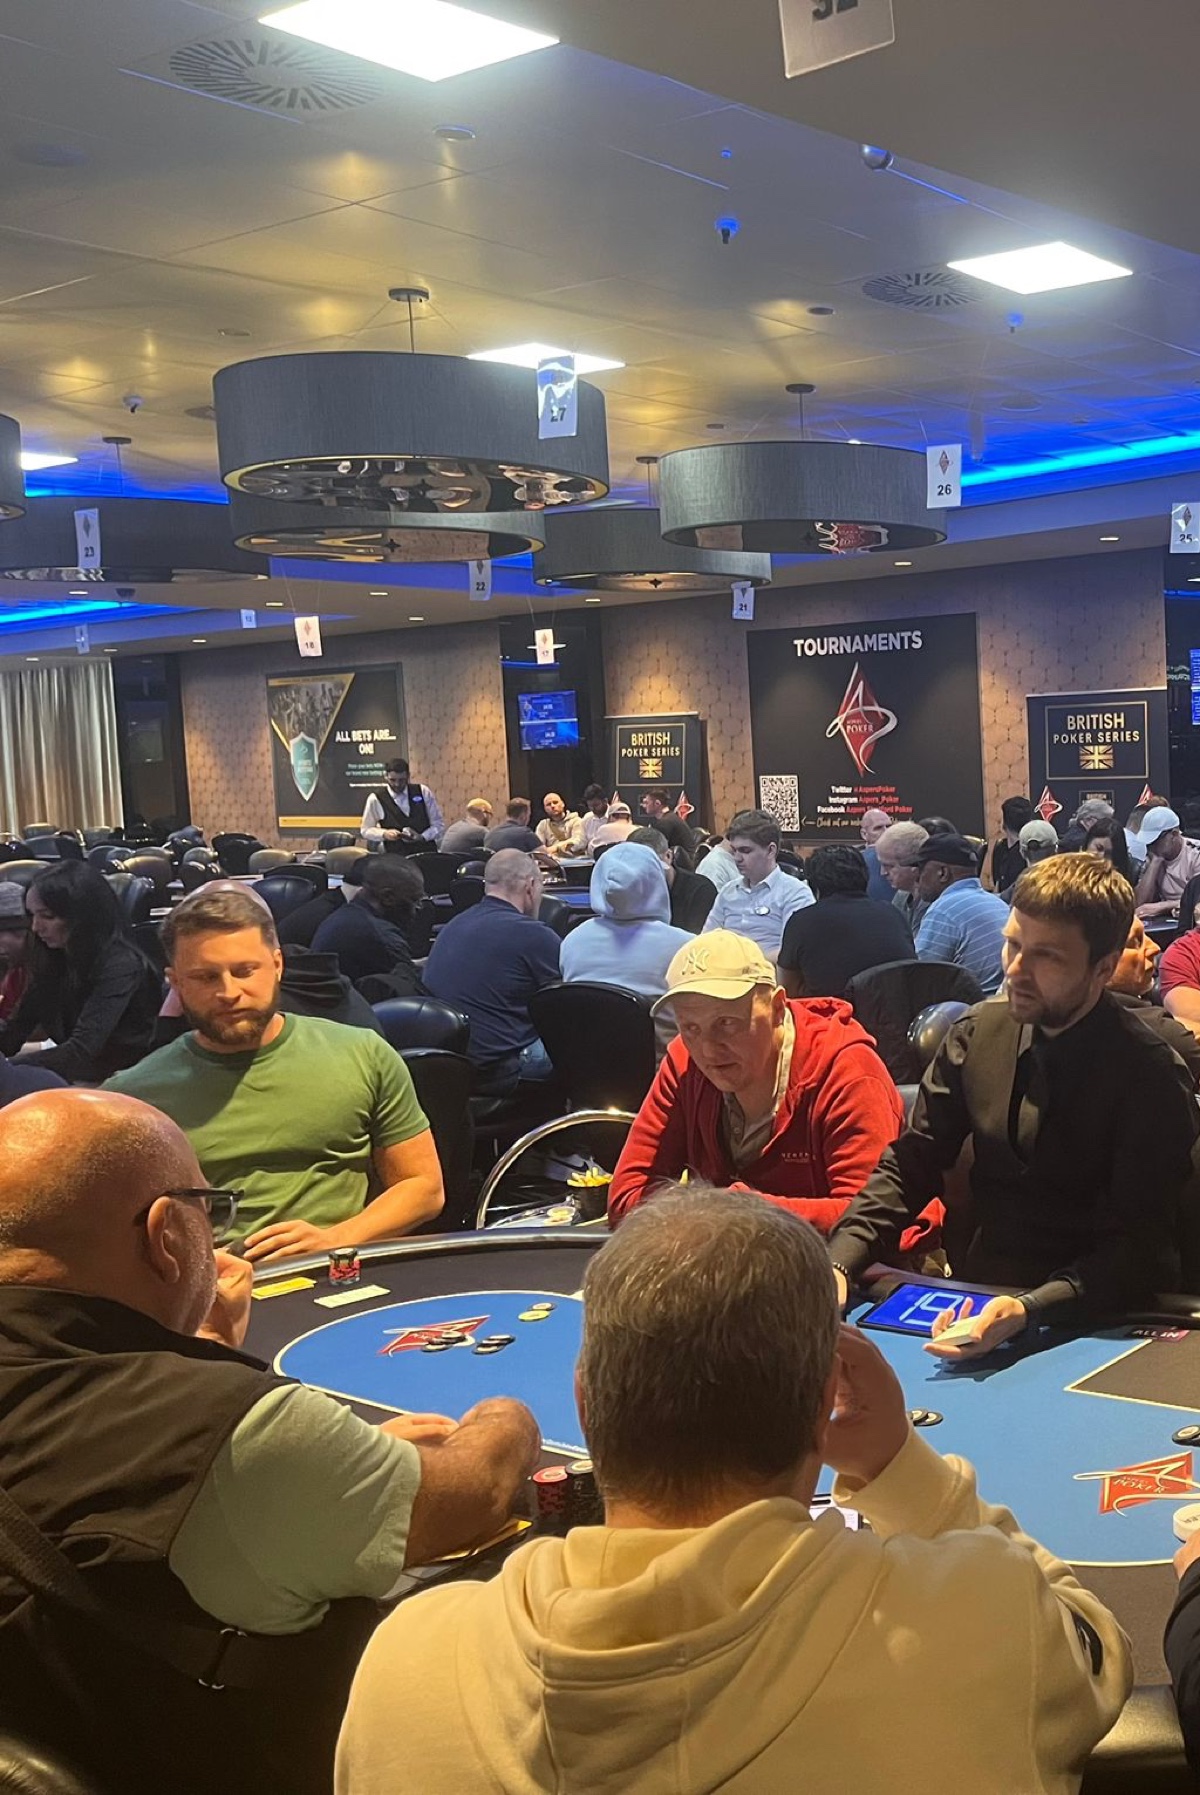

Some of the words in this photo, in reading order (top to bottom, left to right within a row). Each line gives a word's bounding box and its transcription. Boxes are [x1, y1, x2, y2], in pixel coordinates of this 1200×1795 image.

[937, 484, 952, 497] 26
[1179, 533, 1193, 543] 25
[476, 581, 486, 591] 22
[793, 630, 923, 656] TOURNAMENTS
[1067, 711, 1125, 731] BRITISH
[335, 730, 351, 743] ALL
[351, 729, 372, 742] BETS
[631, 731, 670, 746] BRITISH
[1053, 732, 1093, 744] POKER
[1097, 730, 1140, 743] SERIES
[621, 747, 649, 757] POKER
[651, 746, 681, 757] SERIES
